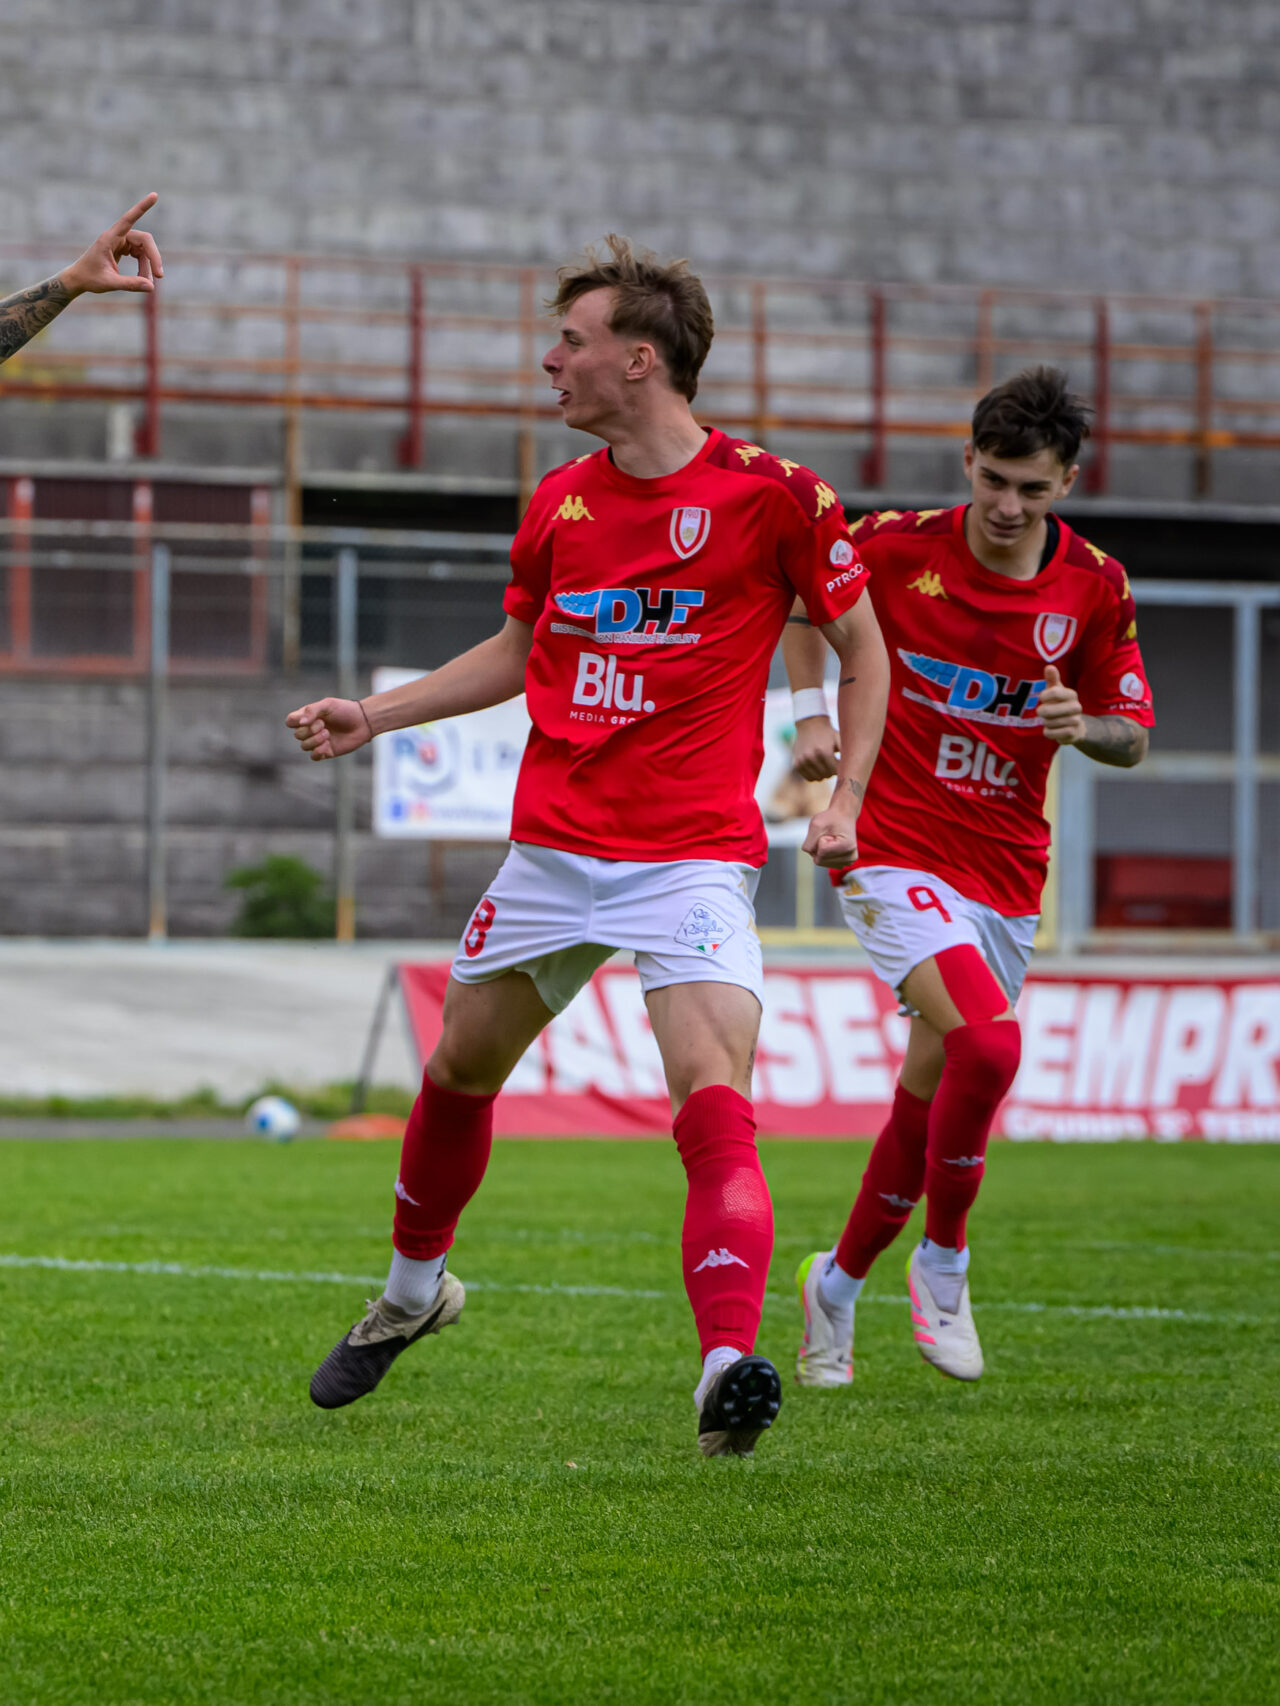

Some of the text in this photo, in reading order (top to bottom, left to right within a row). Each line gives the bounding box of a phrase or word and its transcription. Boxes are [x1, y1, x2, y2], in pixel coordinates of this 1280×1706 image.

[595, 588, 705, 634] DHF
[572, 652, 655, 713] Blu.
[570, 711, 605, 723] MEDIA
[935, 733, 1019, 786] Blu.
[907, 886, 953, 923] 9
